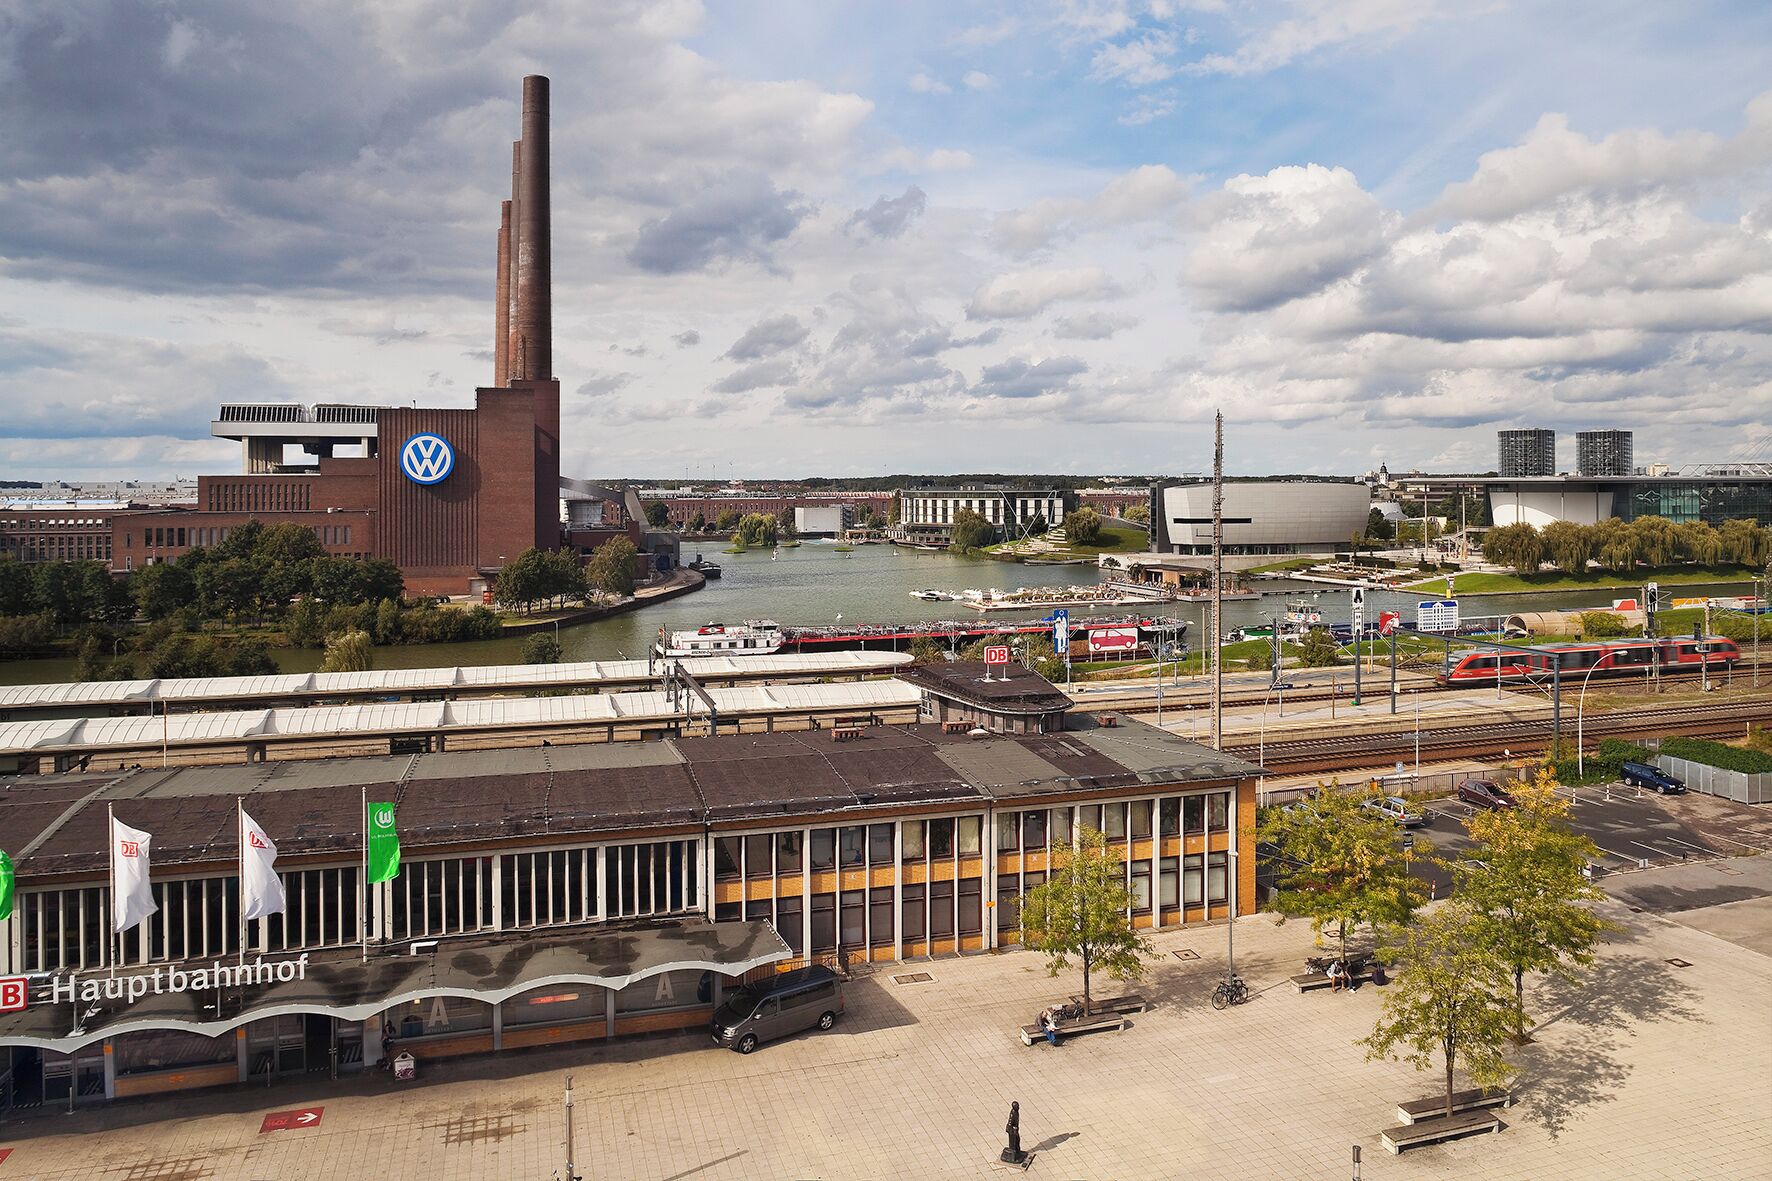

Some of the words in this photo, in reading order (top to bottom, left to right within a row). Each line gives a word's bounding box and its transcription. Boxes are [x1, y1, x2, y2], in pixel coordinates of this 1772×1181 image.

[403, 436, 451, 482] VW
[989, 649, 1007, 662] DB
[121, 843, 135, 855] DB
[52, 953, 309, 1005] Hauptbahnhof
[655, 972, 674, 1001] A
[428, 996, 449, 1027] A
